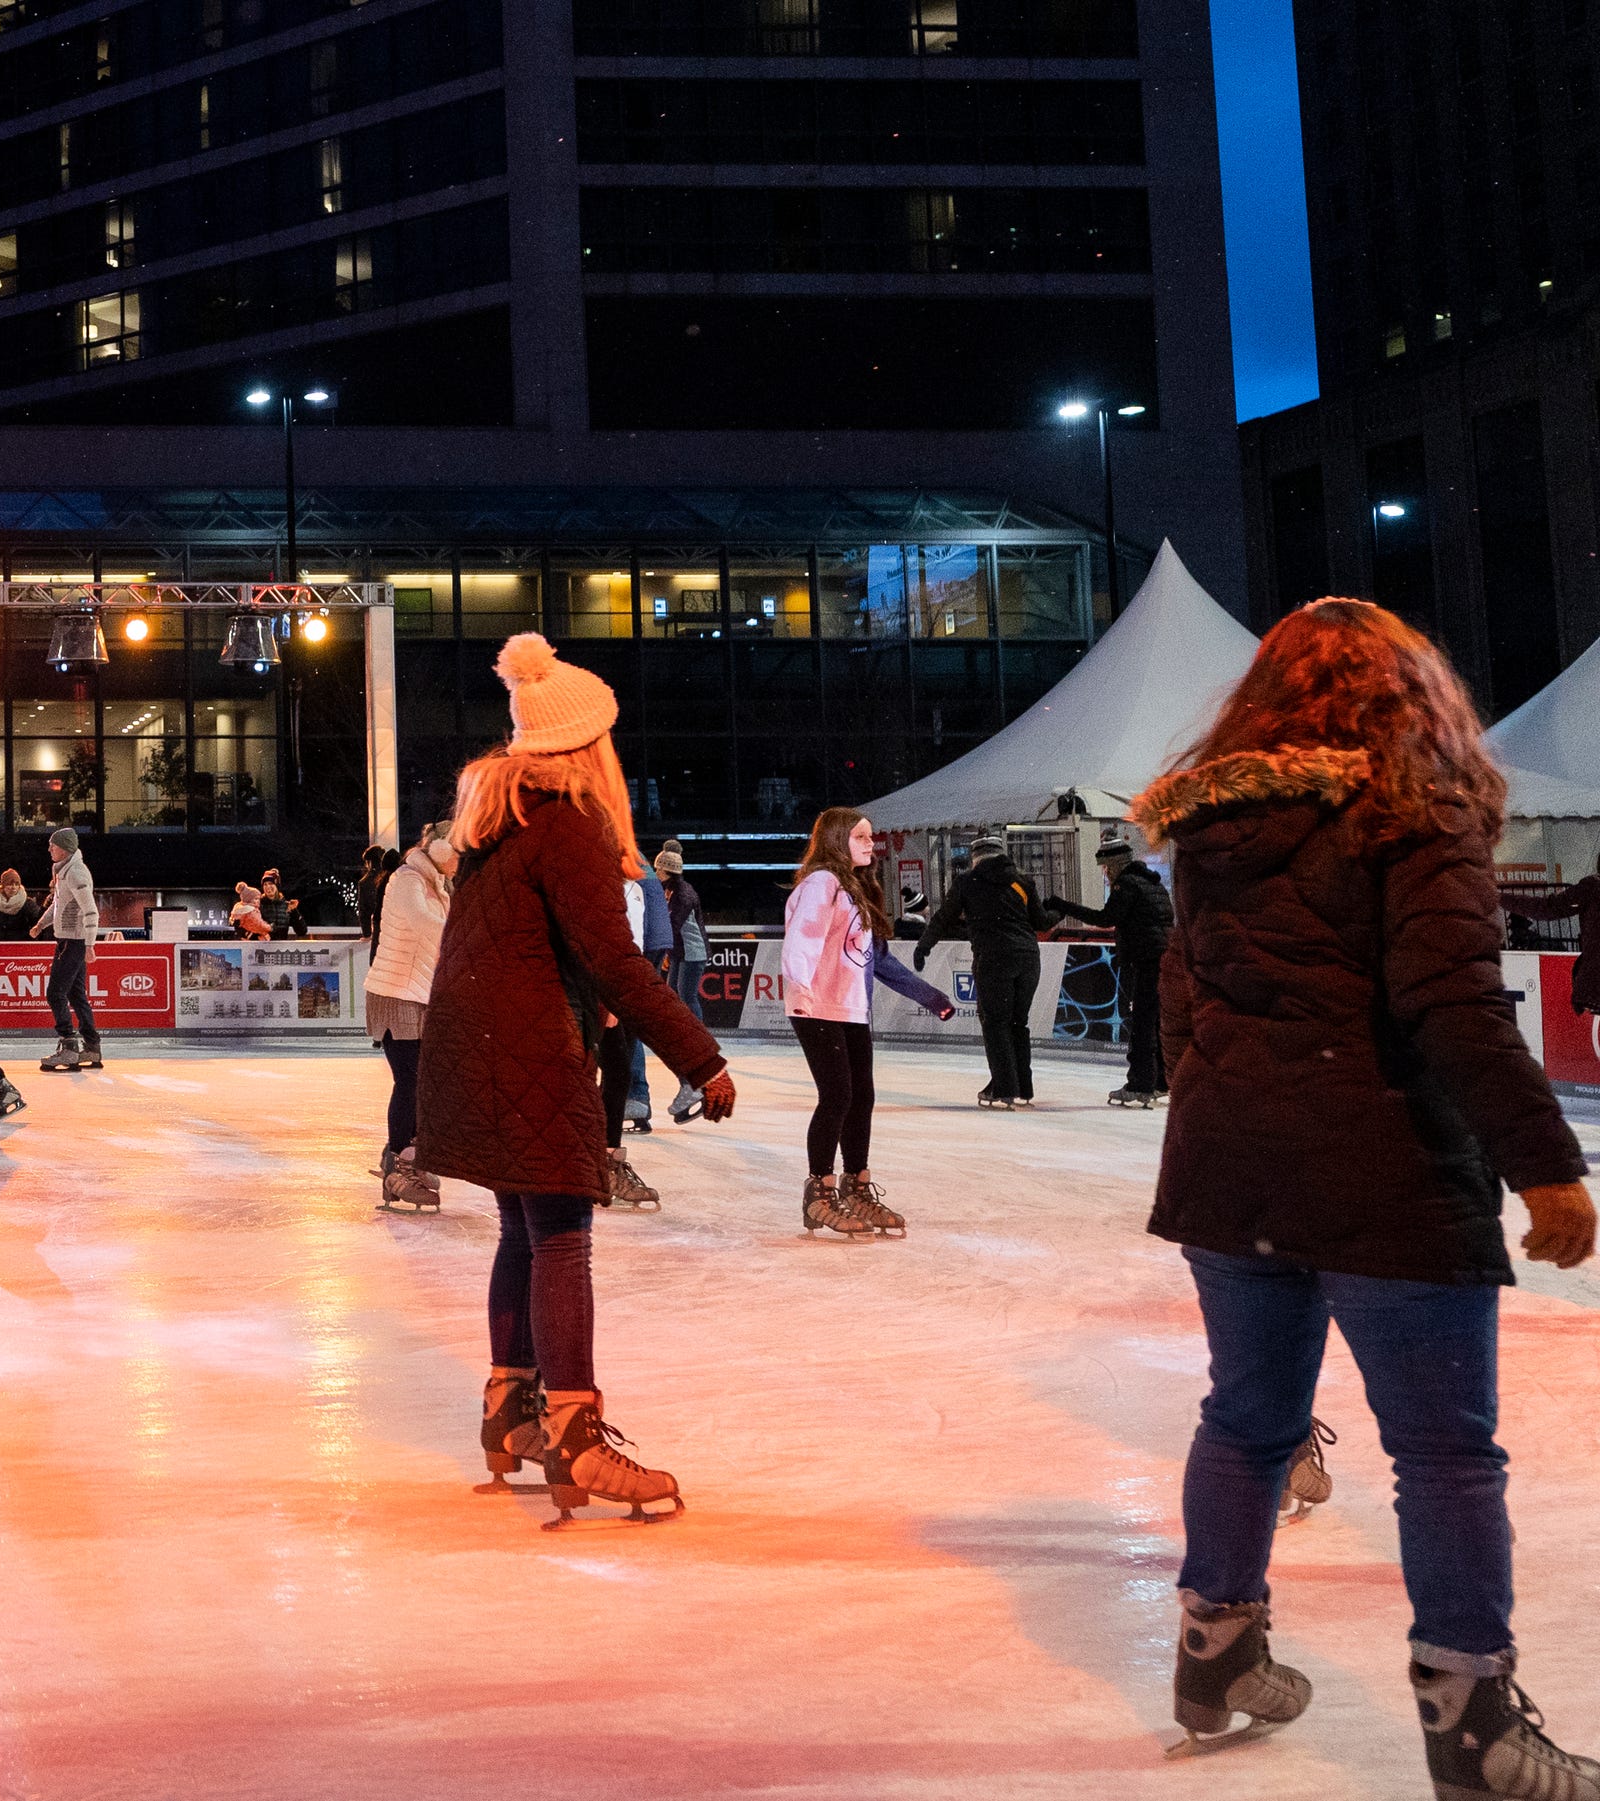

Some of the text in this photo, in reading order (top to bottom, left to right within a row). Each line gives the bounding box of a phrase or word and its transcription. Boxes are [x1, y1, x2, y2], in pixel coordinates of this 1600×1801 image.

[1507, 871, 1547, 881] RETURN
[121, 975, 154, 991] ACD
[698, 973, 785, 1001] CE RI
